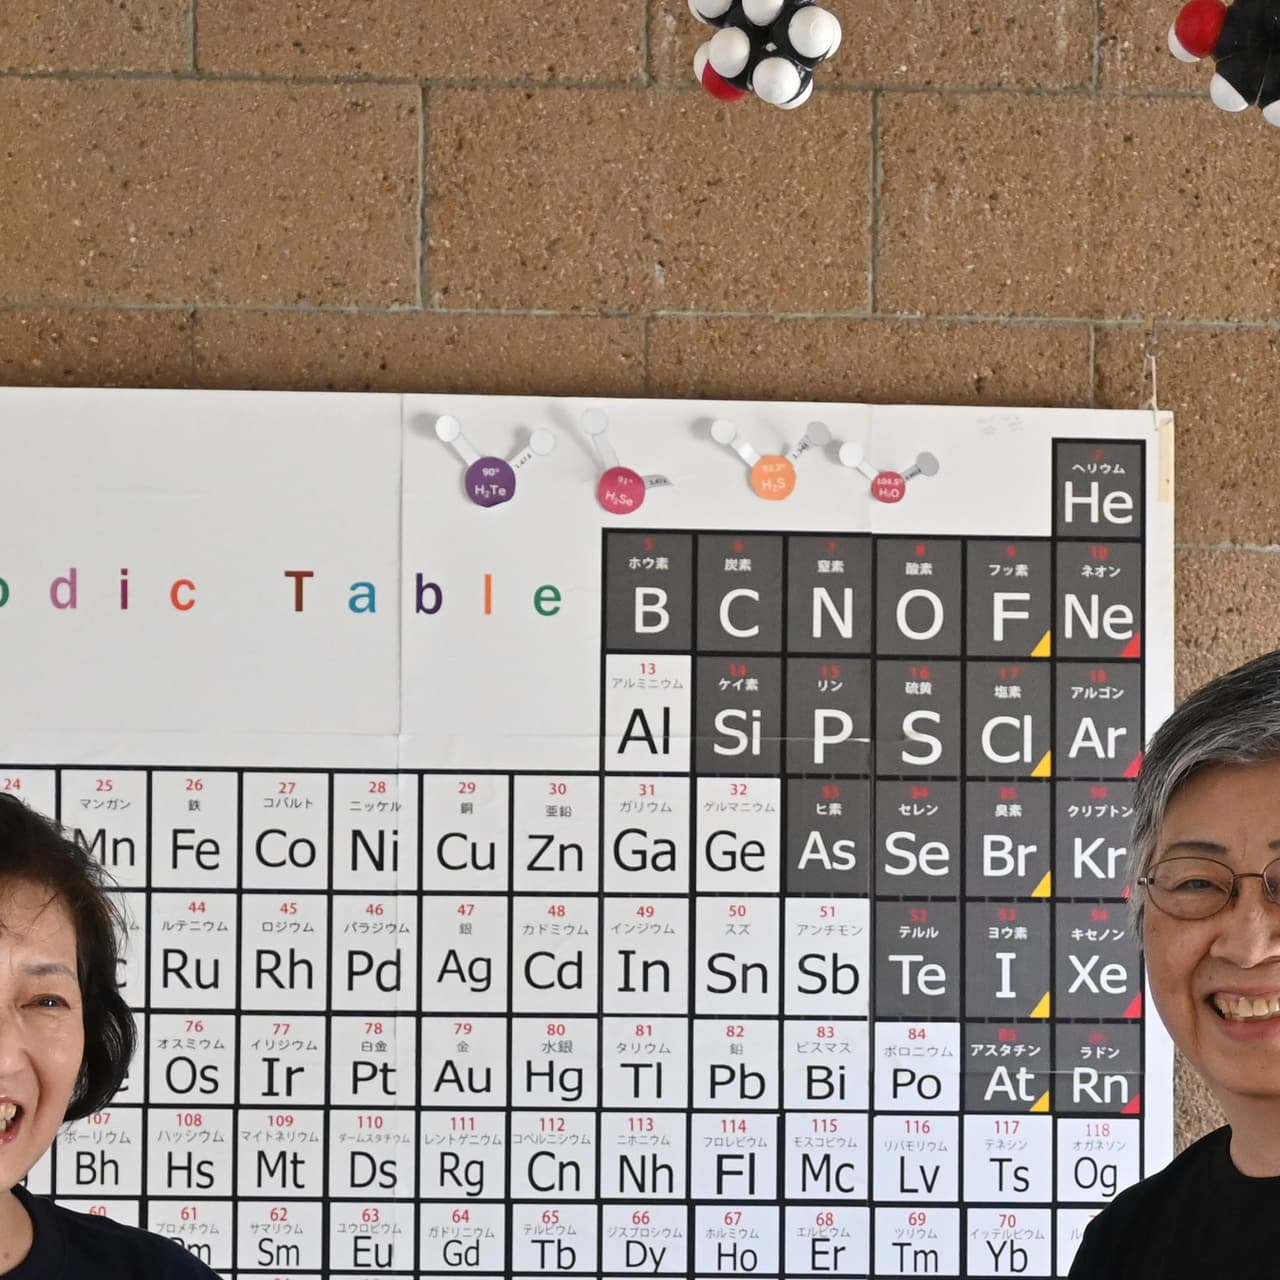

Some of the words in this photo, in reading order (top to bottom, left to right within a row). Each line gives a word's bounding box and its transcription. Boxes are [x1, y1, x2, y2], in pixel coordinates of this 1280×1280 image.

[1072, 464, 1125, 474] ヘリウム
[1065, 481, 1133, 524] He
[725, 558, 751, 572] 炭素
[817, 560, 844, 573] 窒素
[905, 561, 933, 576] 酸素
[989, 564, 1028, 576] フッ素
[1082, 565, 1120, 577] ネオン
[284, 571, 561, 616] Table
[635, 587, 669, 633] B
[720, 589, 759, 637] C
[813, 588, 852, 638] N
[897, 589, 943, 640] O
[994, 593, 1030, 641] F
[641, 663, 655, 675] 13
[719, 678, 758, 691] ケイ素
[818, 680, 842, 691] リン
[904, 680, 933, 696] 硫黄
[994, 684, 1021, 698] 塩素
[1072, 687, 1124, 699] アルゴン
[618, 707, 669, 754] Al
[714, 709, 761, 755] Si
[814, 709, 855, 763] P
[982, 715, 1032, 763] Cl
[1069, 718, 1126, 758] Ar
[187, 779, 203, 790] 26
[459, 782, 475, 793] 29
[550, 783, 566, 794] 30
[188, 799, 201, 811] 鉄
[264, 797, 312, 808] コバルト
[460, 803, 474, 814] 銅
[544, 804, 573, 817] 亜鉛
[172, 829, 219, 870] Fe
[256, 829, 315, 867] Co
[437, 833, 495, 870] Cu
[527, 835, 582, 871] Zn
[706, 830, 765, 872] Ge
[189, 902, 205, 912] 44
[458, 905, 474, 915] 47
[459, 923, 473, 935] 銀
[163, 949, 219, 989] Ru
[437, 949, 491, 992] Ag
[707, 953, 767, 993] Sn
[365, 1023, 382, 1034] 78
[455, 1023, 472, 1034] 79
[547, 1024, 565, 1036] 80
[362, 1041, 387, 1052] 白金
[542, 1039, 572, 1053] 水銀
[353, 1061, 396, 1095] Pt
[434, 1060, 490, 1093] Au
[527, 1060, 582, 1101] Hg
[629, 1118, 653, 1131] 113
[1087, 1124, 1110, 1136] 118
[618, 1135, 670, 1145] ニホニウム
[620, 1155, 673, 1193] Nh
[1074, 1158, 1118, 1197] Og
[354, 1237, 392, 1268] Eu
